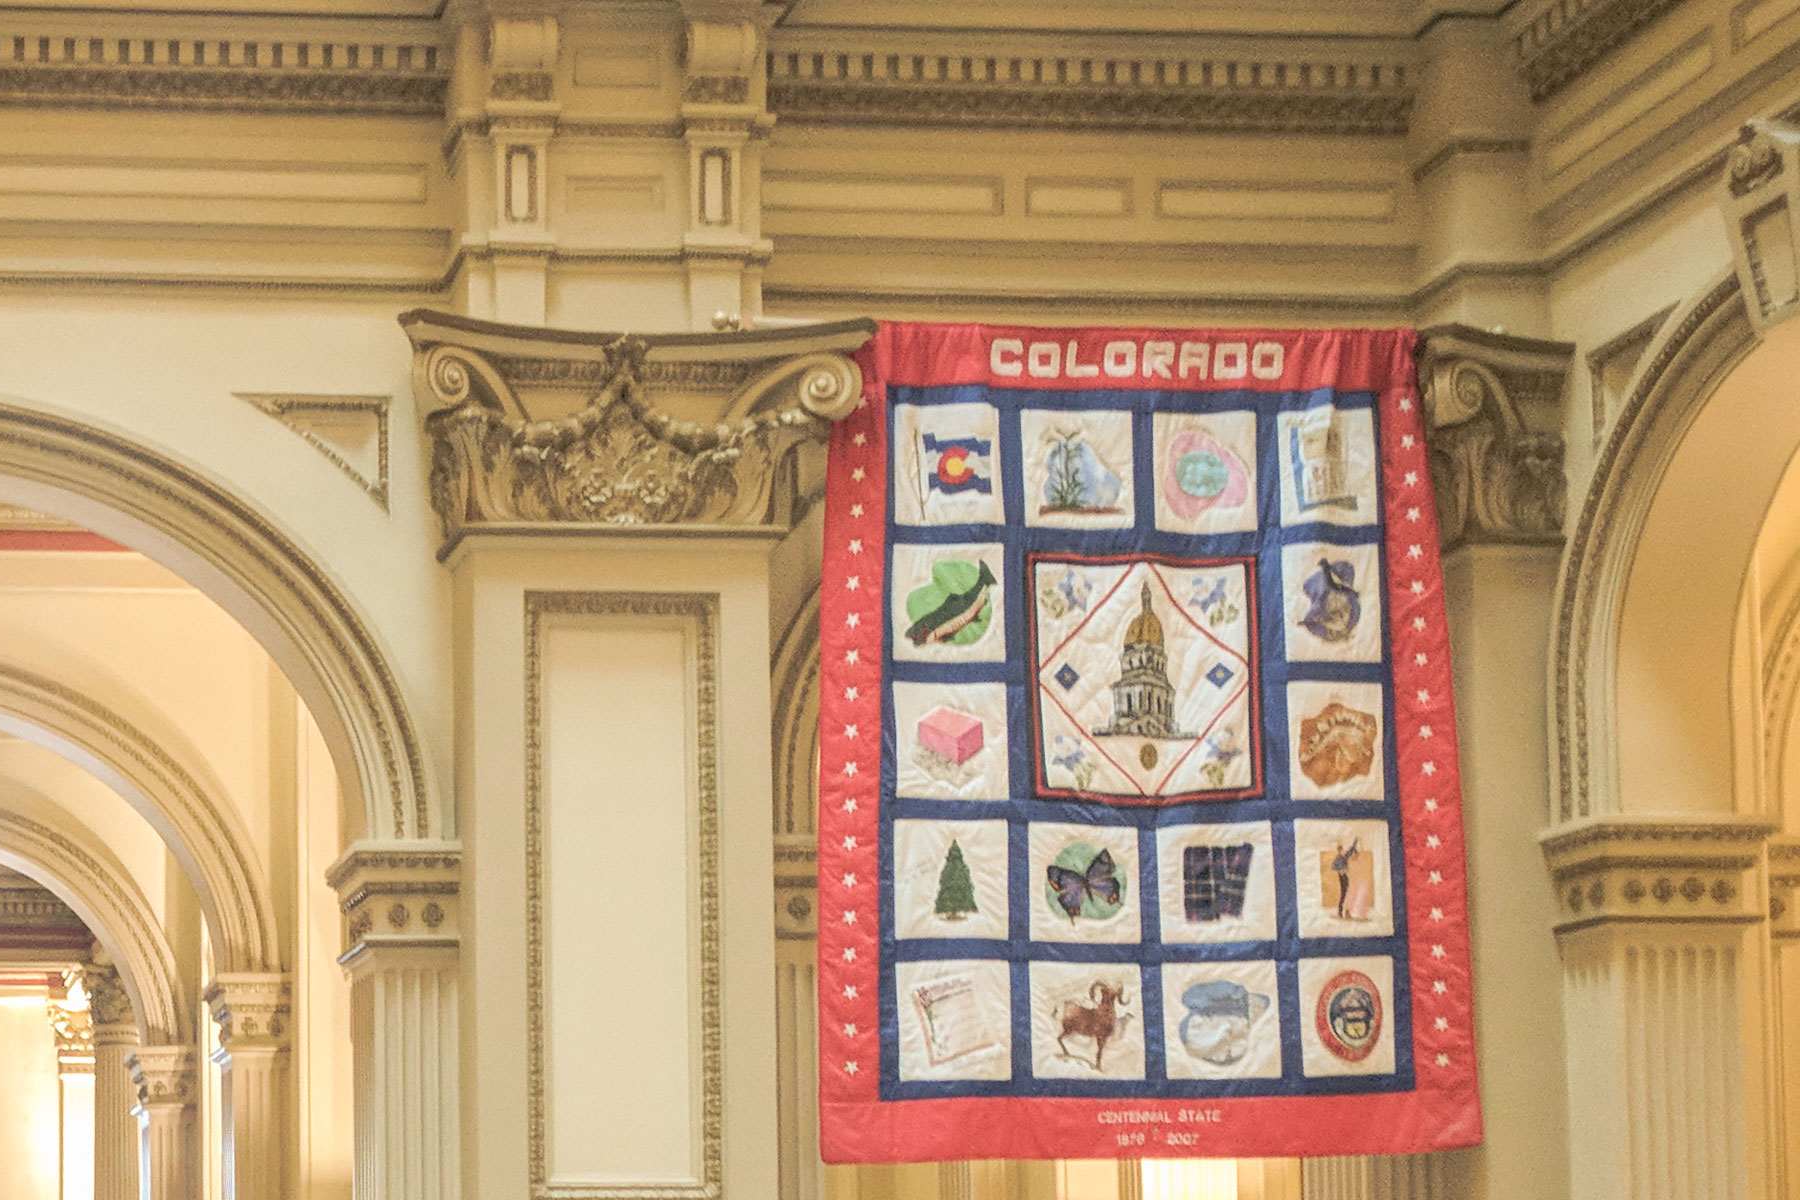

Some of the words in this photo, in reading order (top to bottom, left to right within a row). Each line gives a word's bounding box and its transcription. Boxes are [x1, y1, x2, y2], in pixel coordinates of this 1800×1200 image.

[990, 338, 1285, 380] COLORADO
[1097, 1111, 1172, 1124] CENTENNIAL
[1178, 1109, 1222, 1123] STATE
